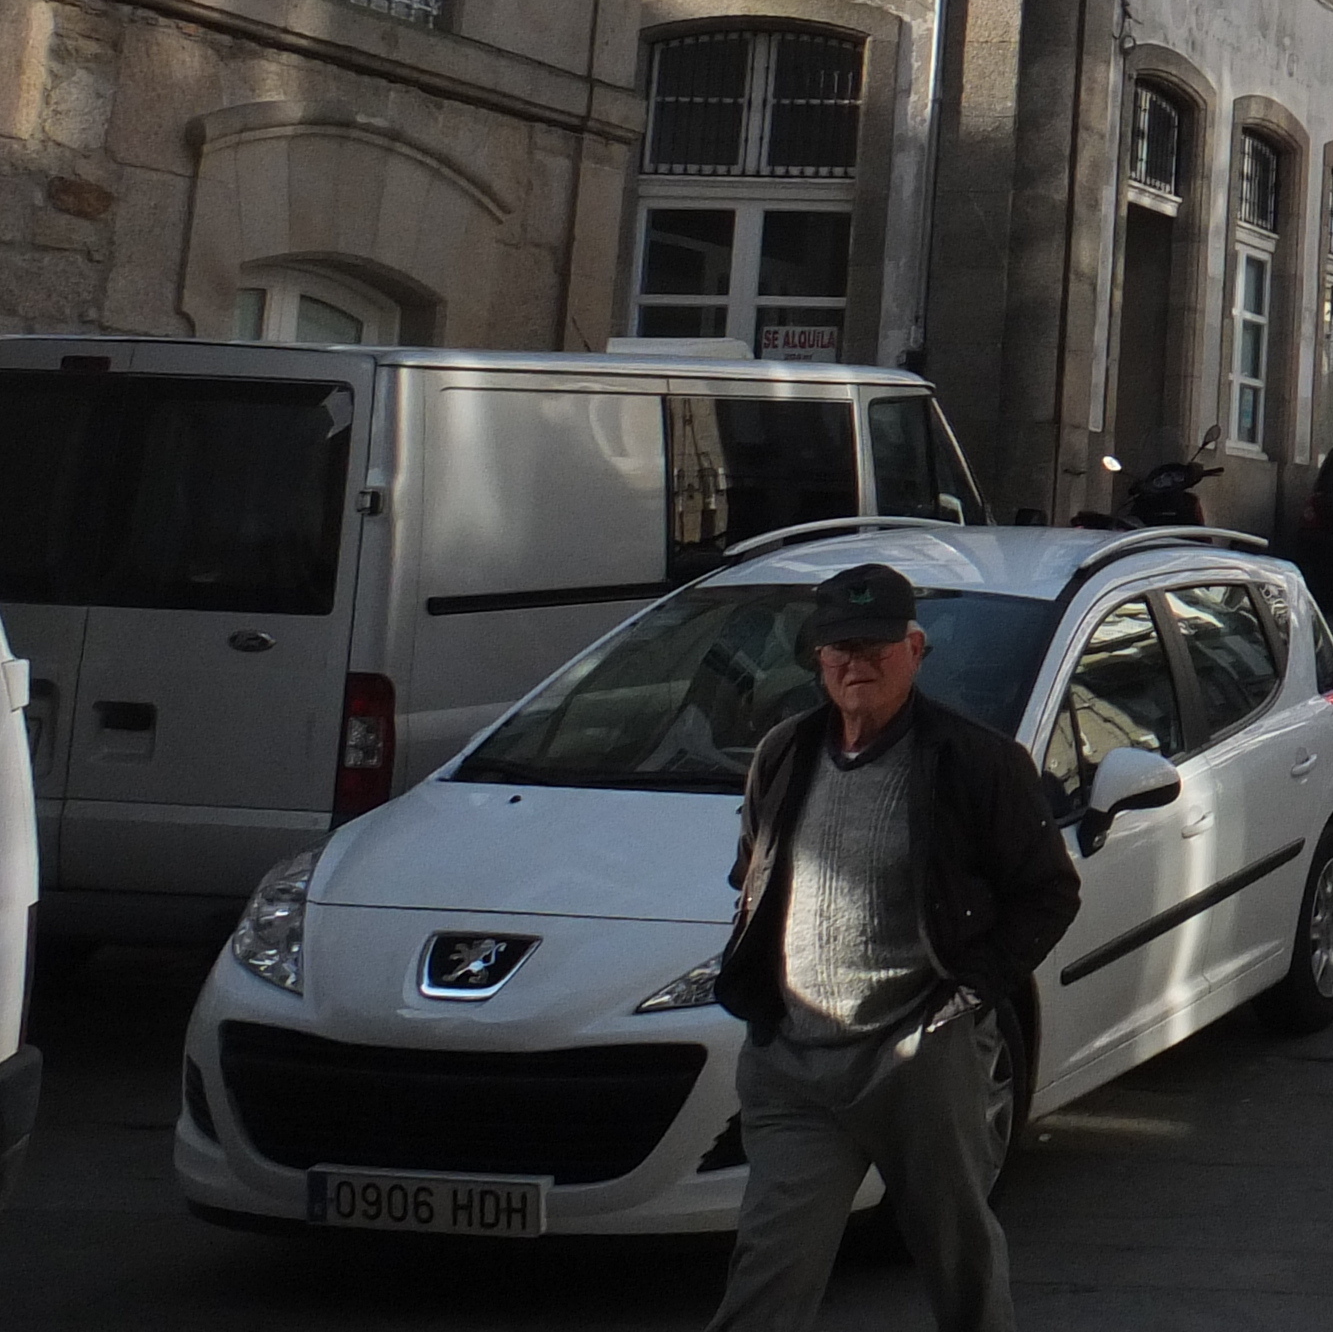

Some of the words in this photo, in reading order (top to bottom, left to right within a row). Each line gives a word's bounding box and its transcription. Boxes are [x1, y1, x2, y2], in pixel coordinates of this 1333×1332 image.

[763, 329, 779, 349] SE
[335, 1180, 435, 1224] 0906
[452, 1187, 528, 1230] HDH
